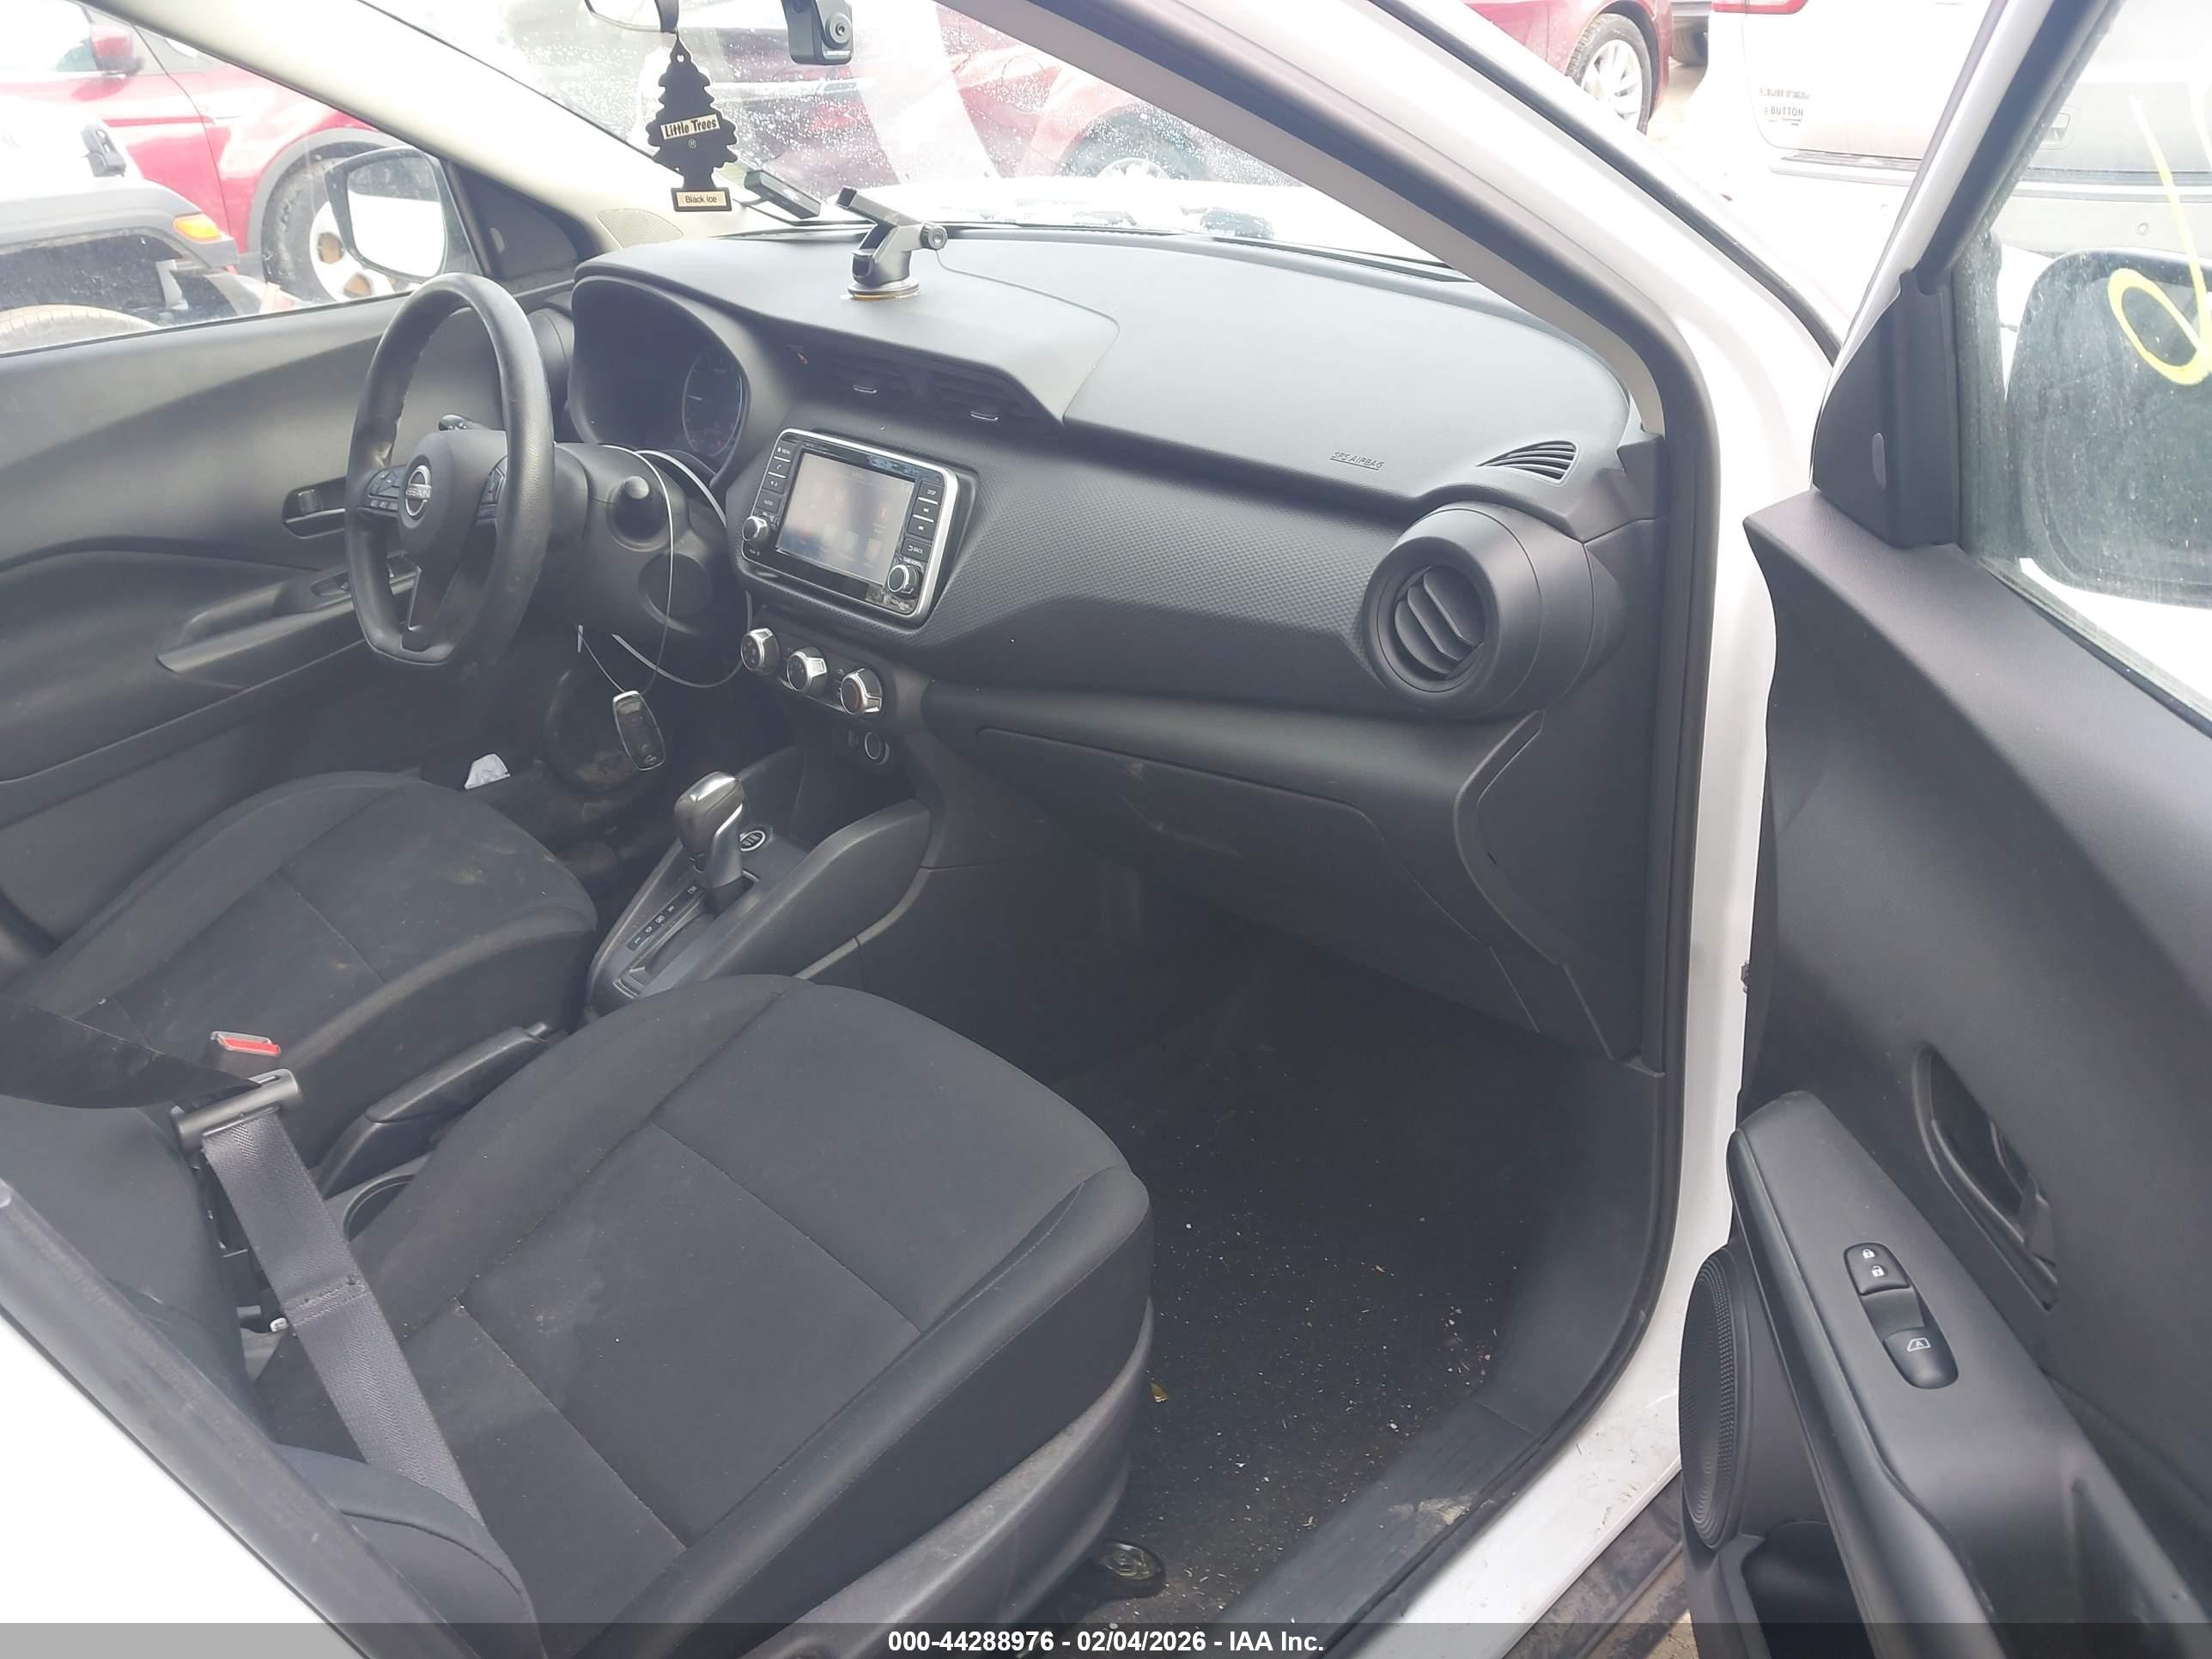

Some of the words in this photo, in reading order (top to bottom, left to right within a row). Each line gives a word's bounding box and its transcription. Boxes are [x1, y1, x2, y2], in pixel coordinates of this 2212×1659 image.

[1771, 106, 1803, 117] BUTTON
[665, 123, 690, 137] Little
[690, 119, 717, 134] Trees
[684, 194, 705, 204] Black
[706, 194, 718, 204] Ice
[1348, 455, 1385, 469] AIRBAG
